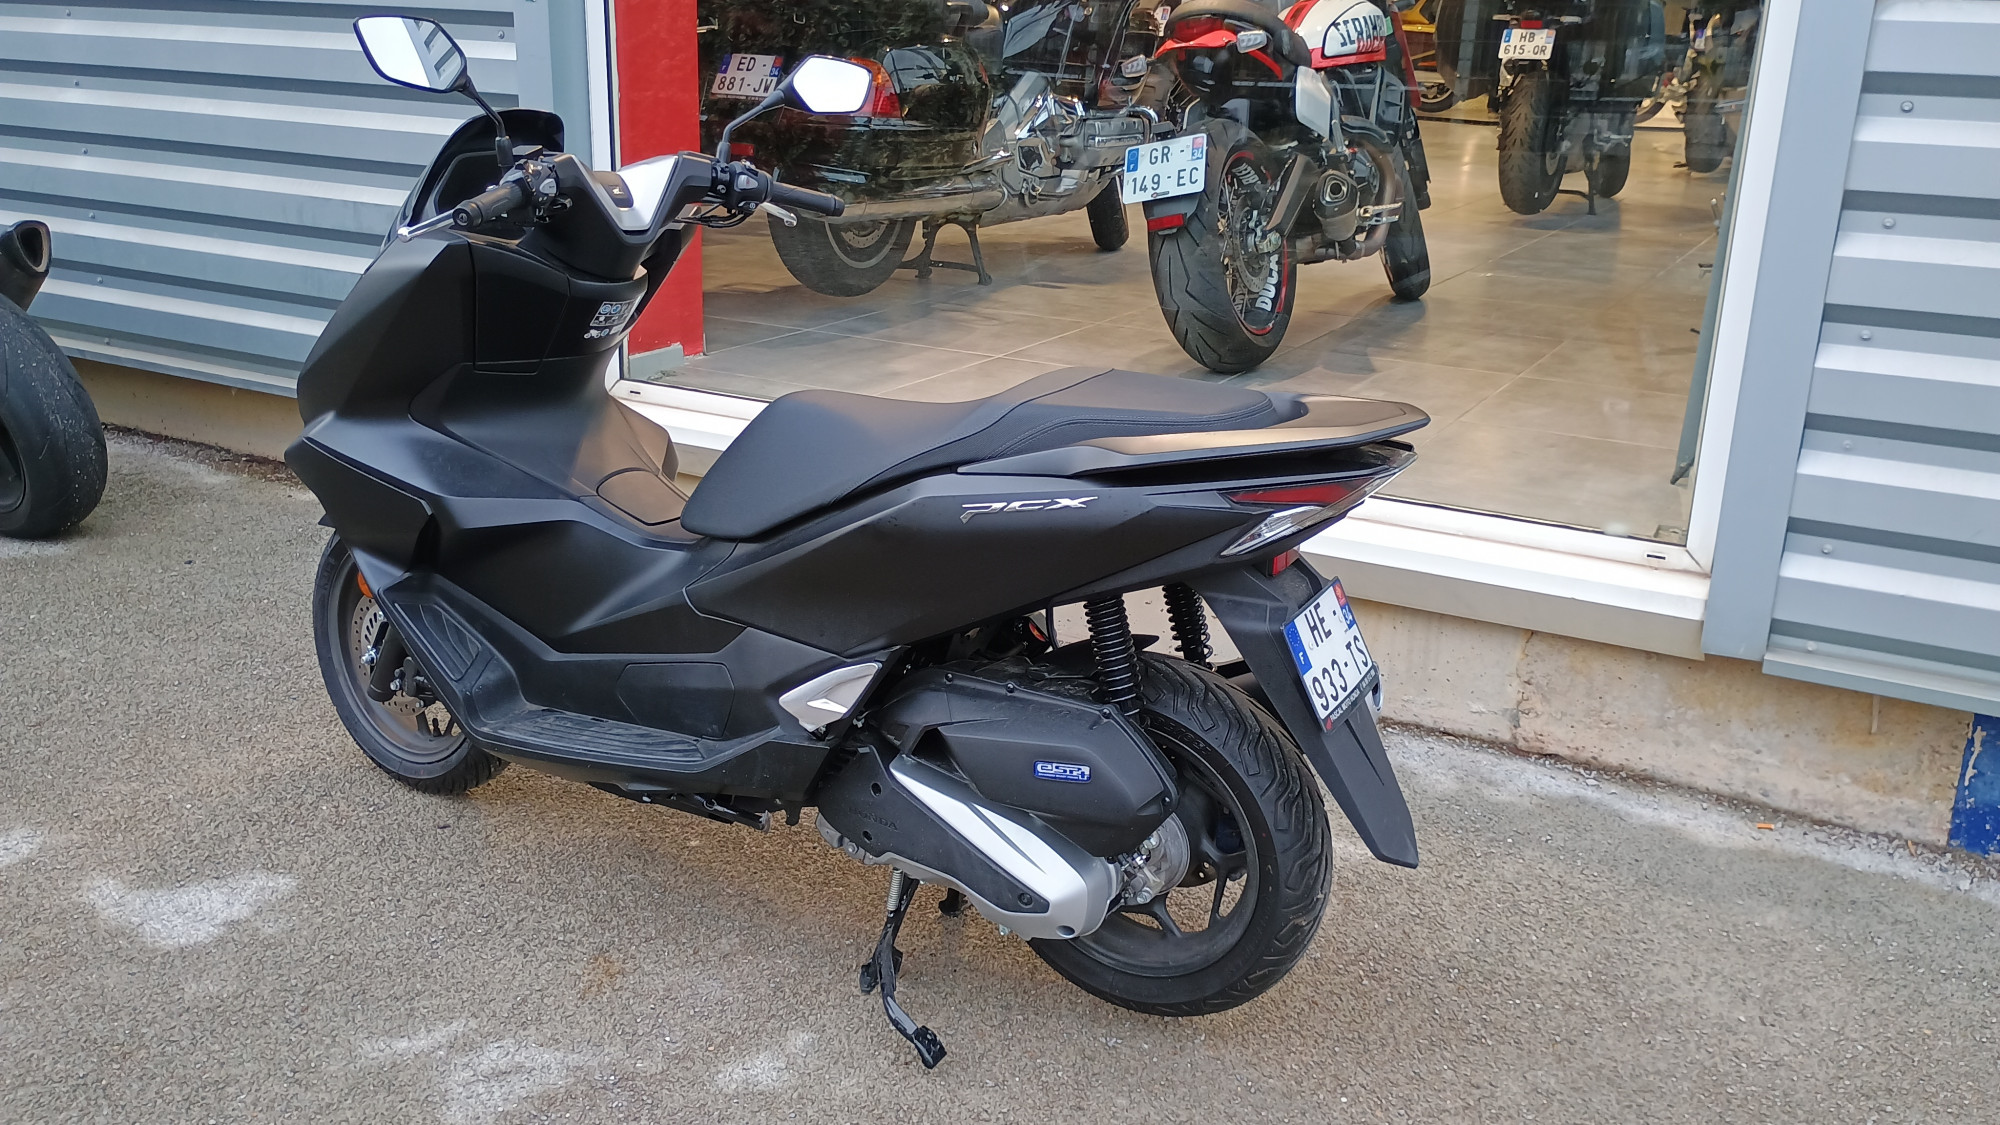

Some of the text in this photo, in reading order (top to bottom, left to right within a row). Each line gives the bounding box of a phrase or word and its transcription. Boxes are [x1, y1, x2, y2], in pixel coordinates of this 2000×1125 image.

[1519, 31, 1536, 43] HB
[736, 56, 757, 72] ED
[717, 75, 774, 94] 881-JW
[1149, 145, 1171, 166] GR
[1191, 148, 1203, 159] 34
[1129, 163, 1136, 171] F
[959, 496, 1099, 525] PCX
[1304, 601, 1333, 648] HE
[1342, 605, 1355, 625] 34
[1298, 651, 1305, 665] F
[1312, 634, 1369, 712] 933-TS
